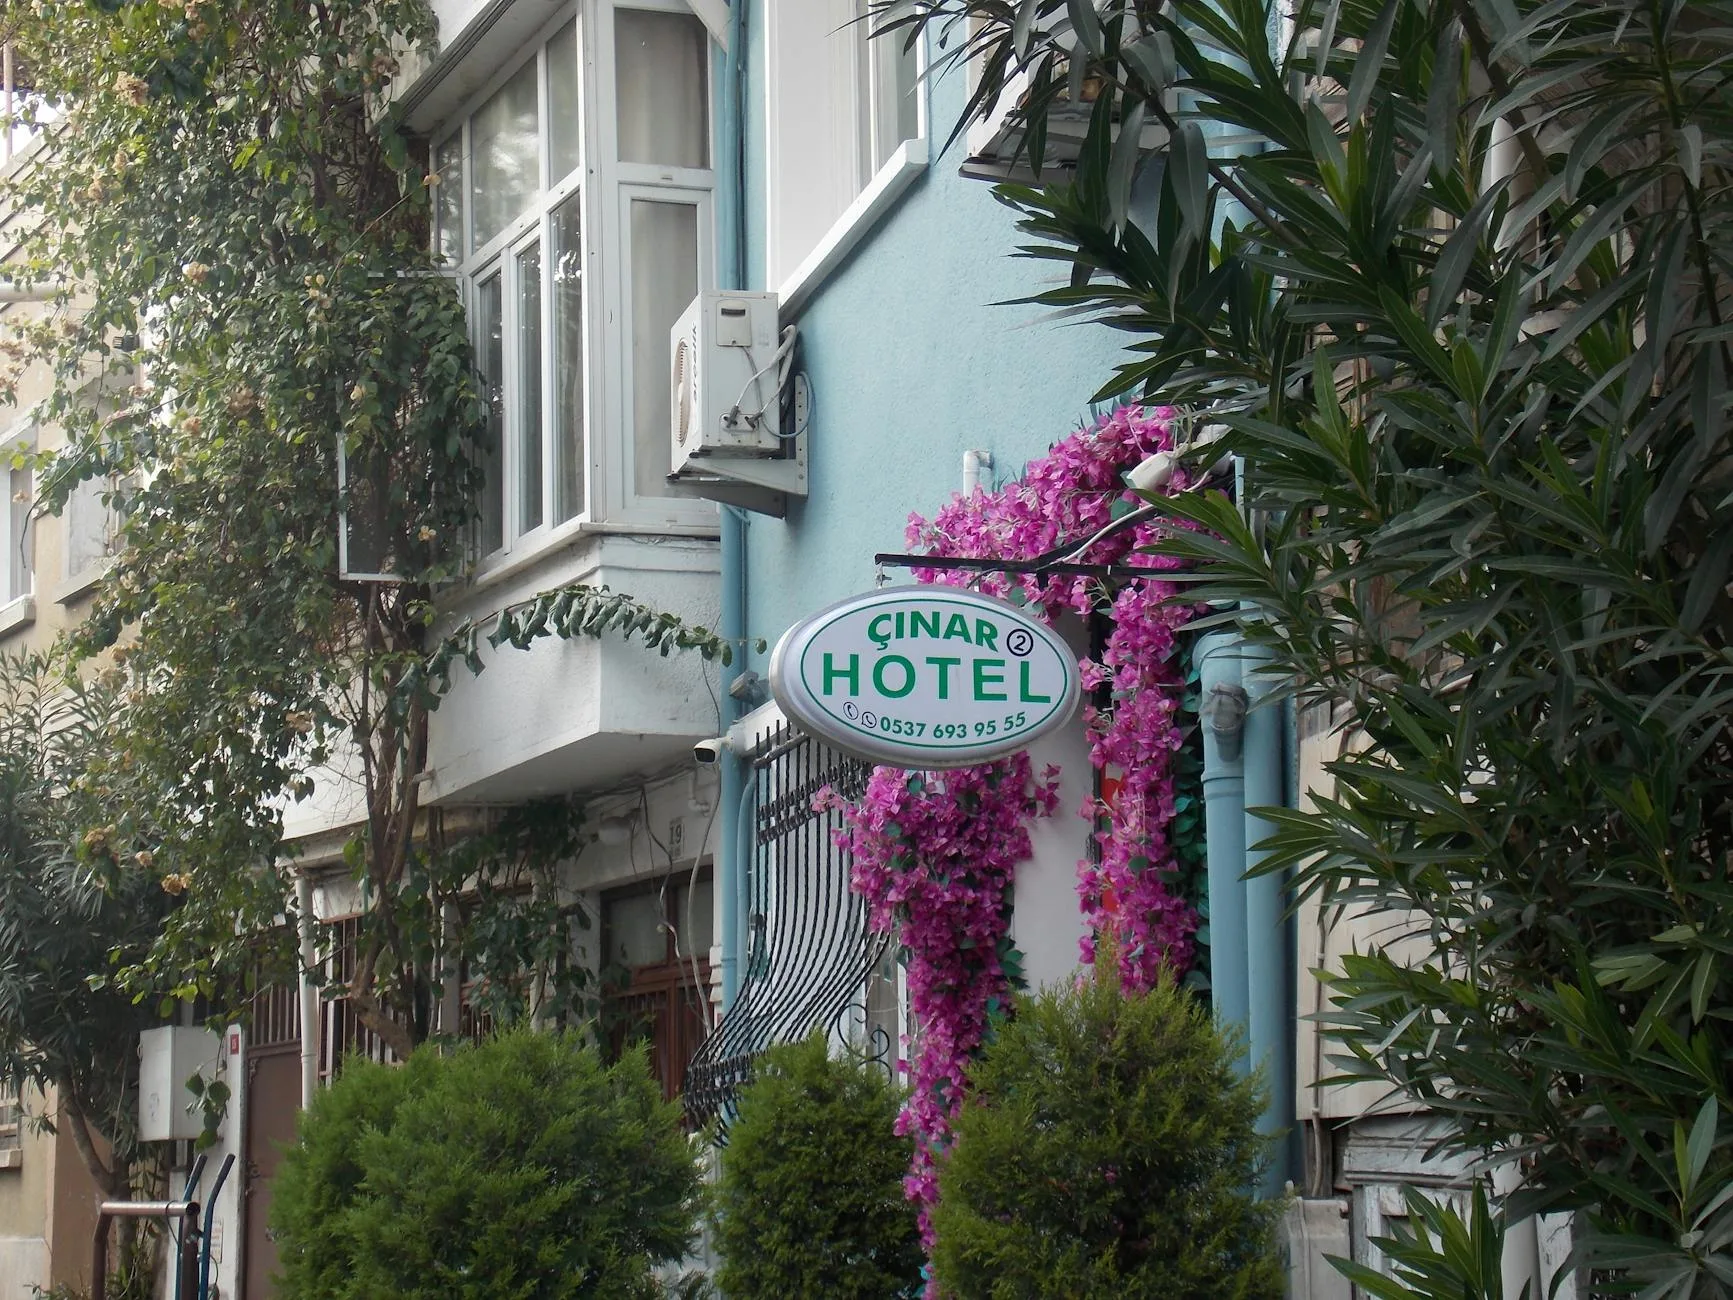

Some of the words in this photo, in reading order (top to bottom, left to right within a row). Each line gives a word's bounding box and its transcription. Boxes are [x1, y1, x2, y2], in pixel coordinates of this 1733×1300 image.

[868, 611, 998, 652] ÇINAR
[823, 653, 1051, 703] HOTEL
[880, 716, 926, 738] 0537
[933, 723, 967, 739] 693
[975, 720, 996, 736] 95
[1004, 712, 1026, 731] 55
